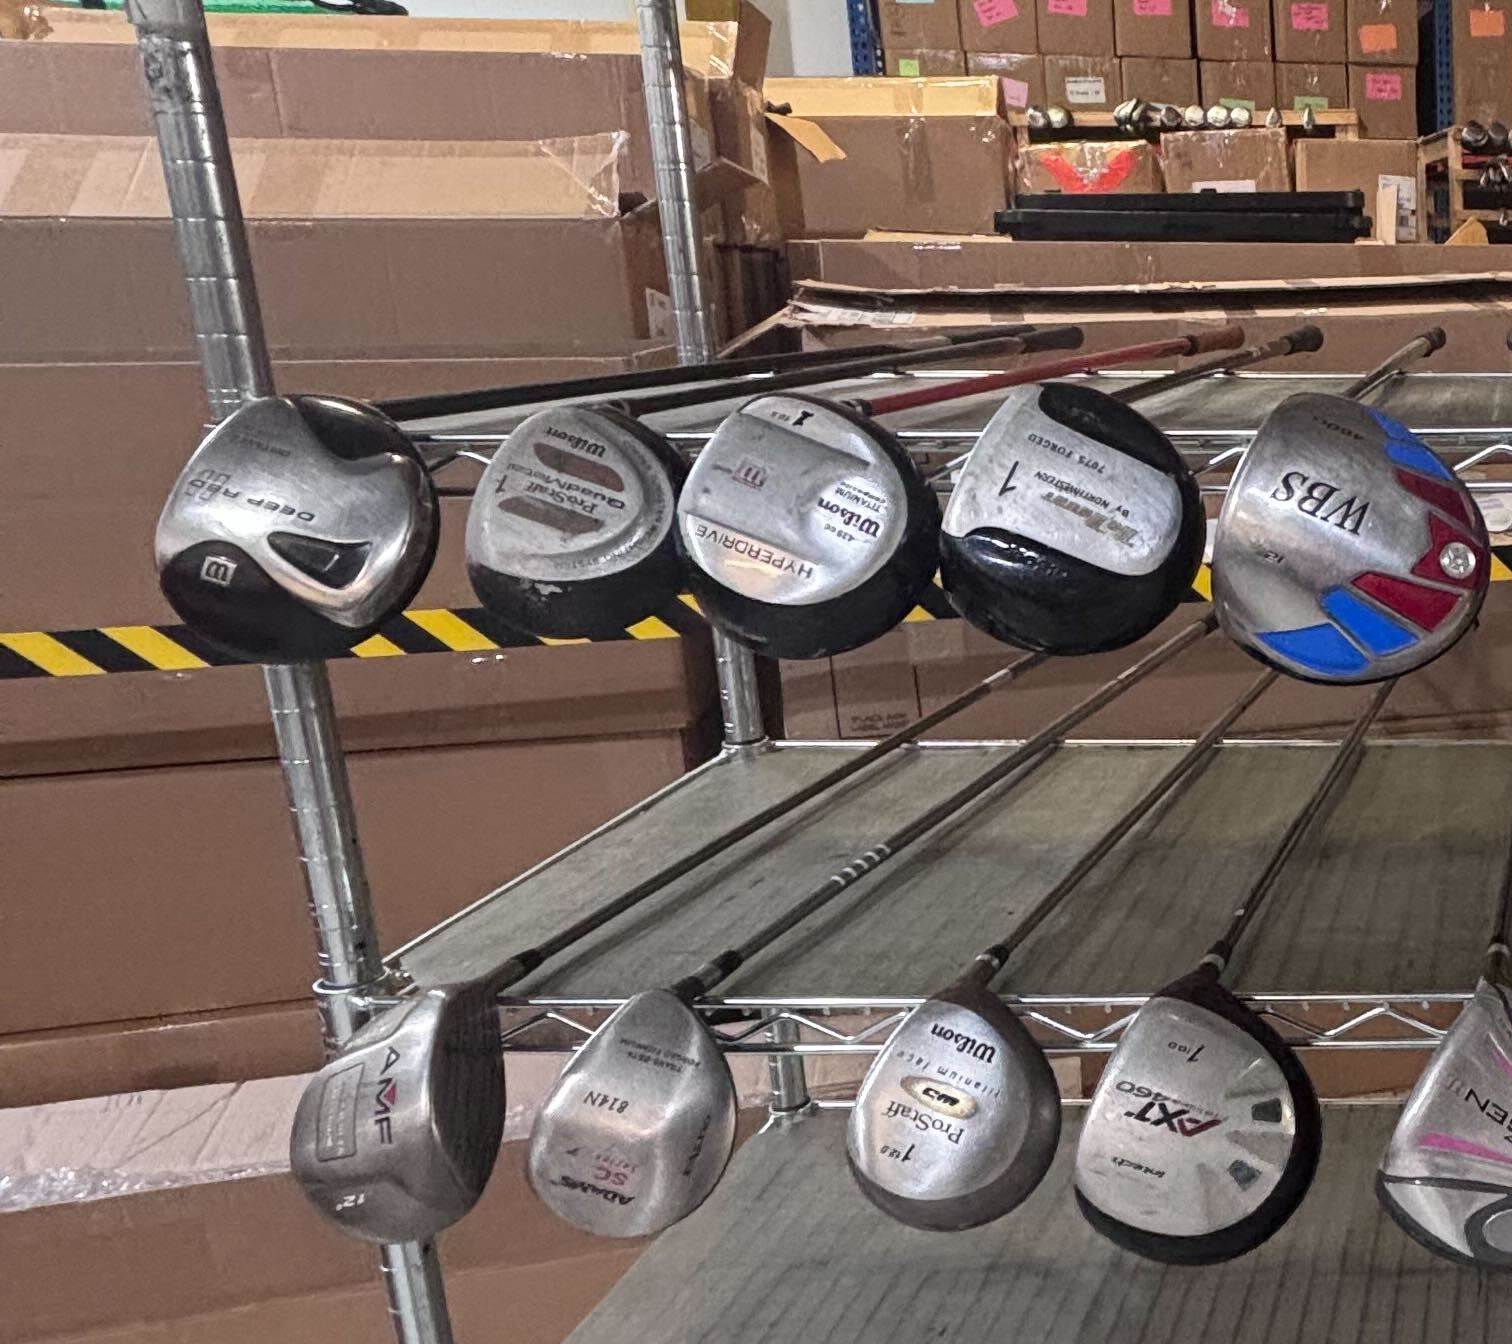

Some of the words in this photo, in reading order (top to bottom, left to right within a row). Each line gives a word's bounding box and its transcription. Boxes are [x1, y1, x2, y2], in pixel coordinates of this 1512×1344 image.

[791, 408, 814, 431] 1
[542, 426, 608, 459] Wilson
[1027, 432, 1074, 459] FORGED
[999, 461, 1020, 498] 1
[1077, 454, 1107, 474] 7075
[247, 494, 316, 522] DEEP
[523, 480, 600, 516] ProStaff
[834, 486, 882, 513] TITANIUM
[1272, 471, 1371, 535] WBS
[816, 497, 882, 538] Wilson
[694, 524, 814, 580] HYPERDRIVE
[930, 1023, 996, 1064] Wilson
[374, 1047, 400, 1144] AMF
[935, 1065, 1001, 1098] titanium
[1117, 1080, 1176, 1107] 460
[583, 1089, 630, 1116] 814N
[1124, 1101, 1226, 1137] AXT
[886, 1099, 964, 1144] ProStaff
[901, 1142, 915, 1164] 1
[559, 1177, 634, 1205] ADAMS
[594, 1166, 630, 1187] SC
